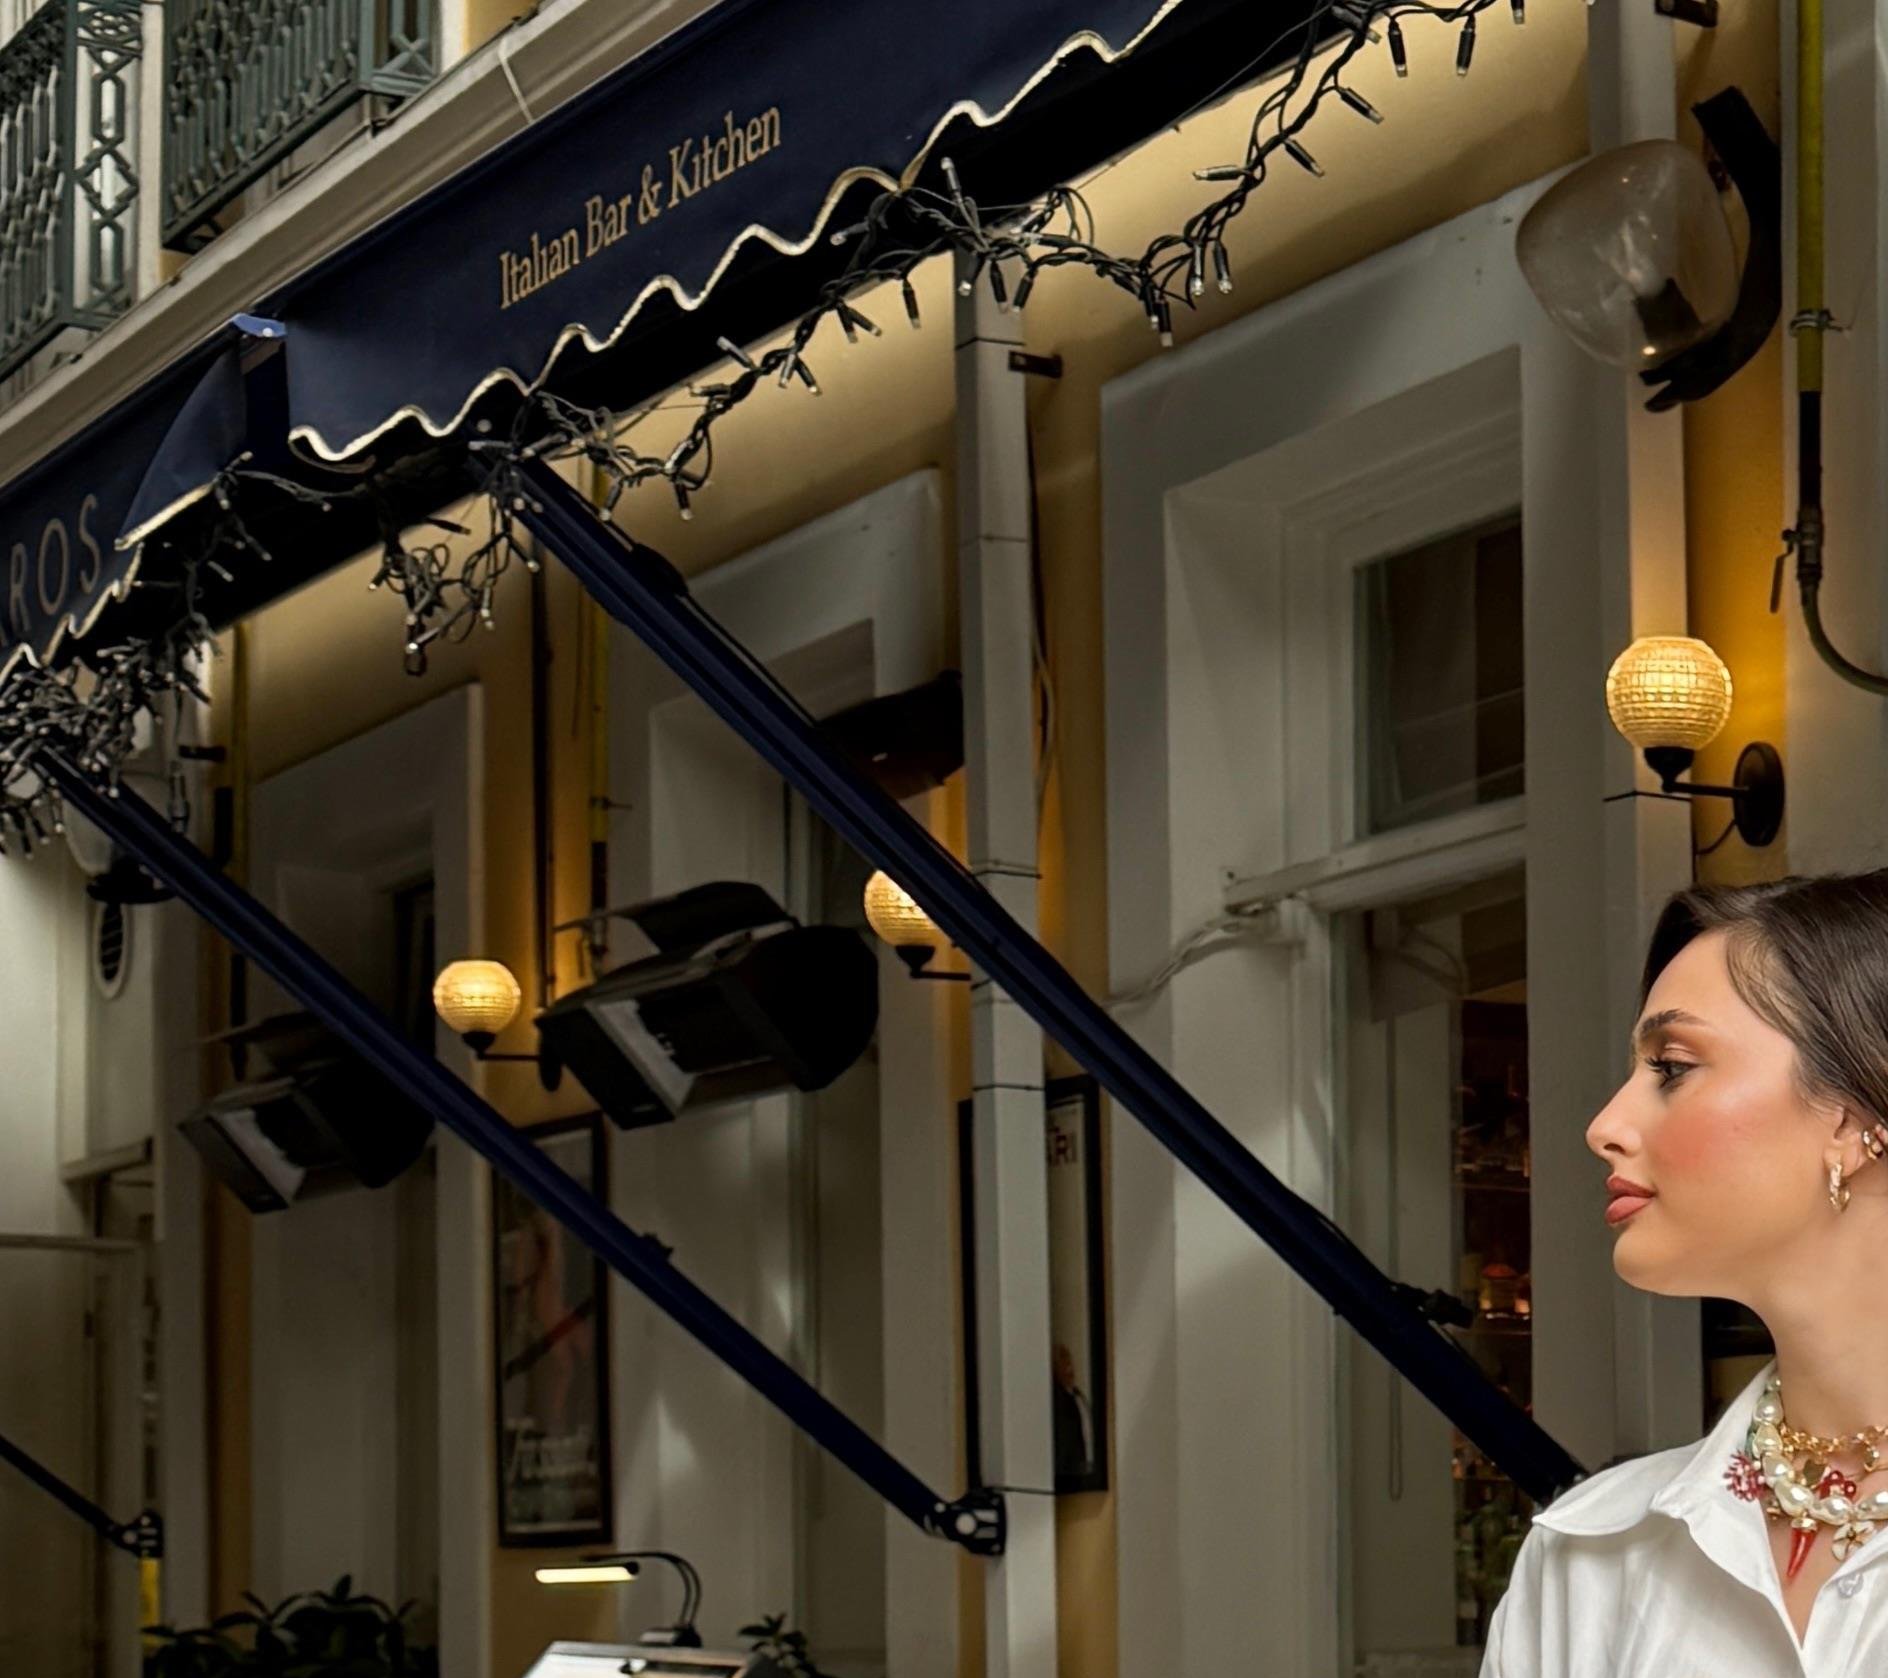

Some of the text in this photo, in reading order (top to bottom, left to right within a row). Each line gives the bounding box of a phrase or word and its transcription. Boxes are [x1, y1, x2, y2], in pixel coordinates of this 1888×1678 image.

[500, 106, 781, 310] Italian Bar & Kitchen
[0, 493, 101, 647] ROS
